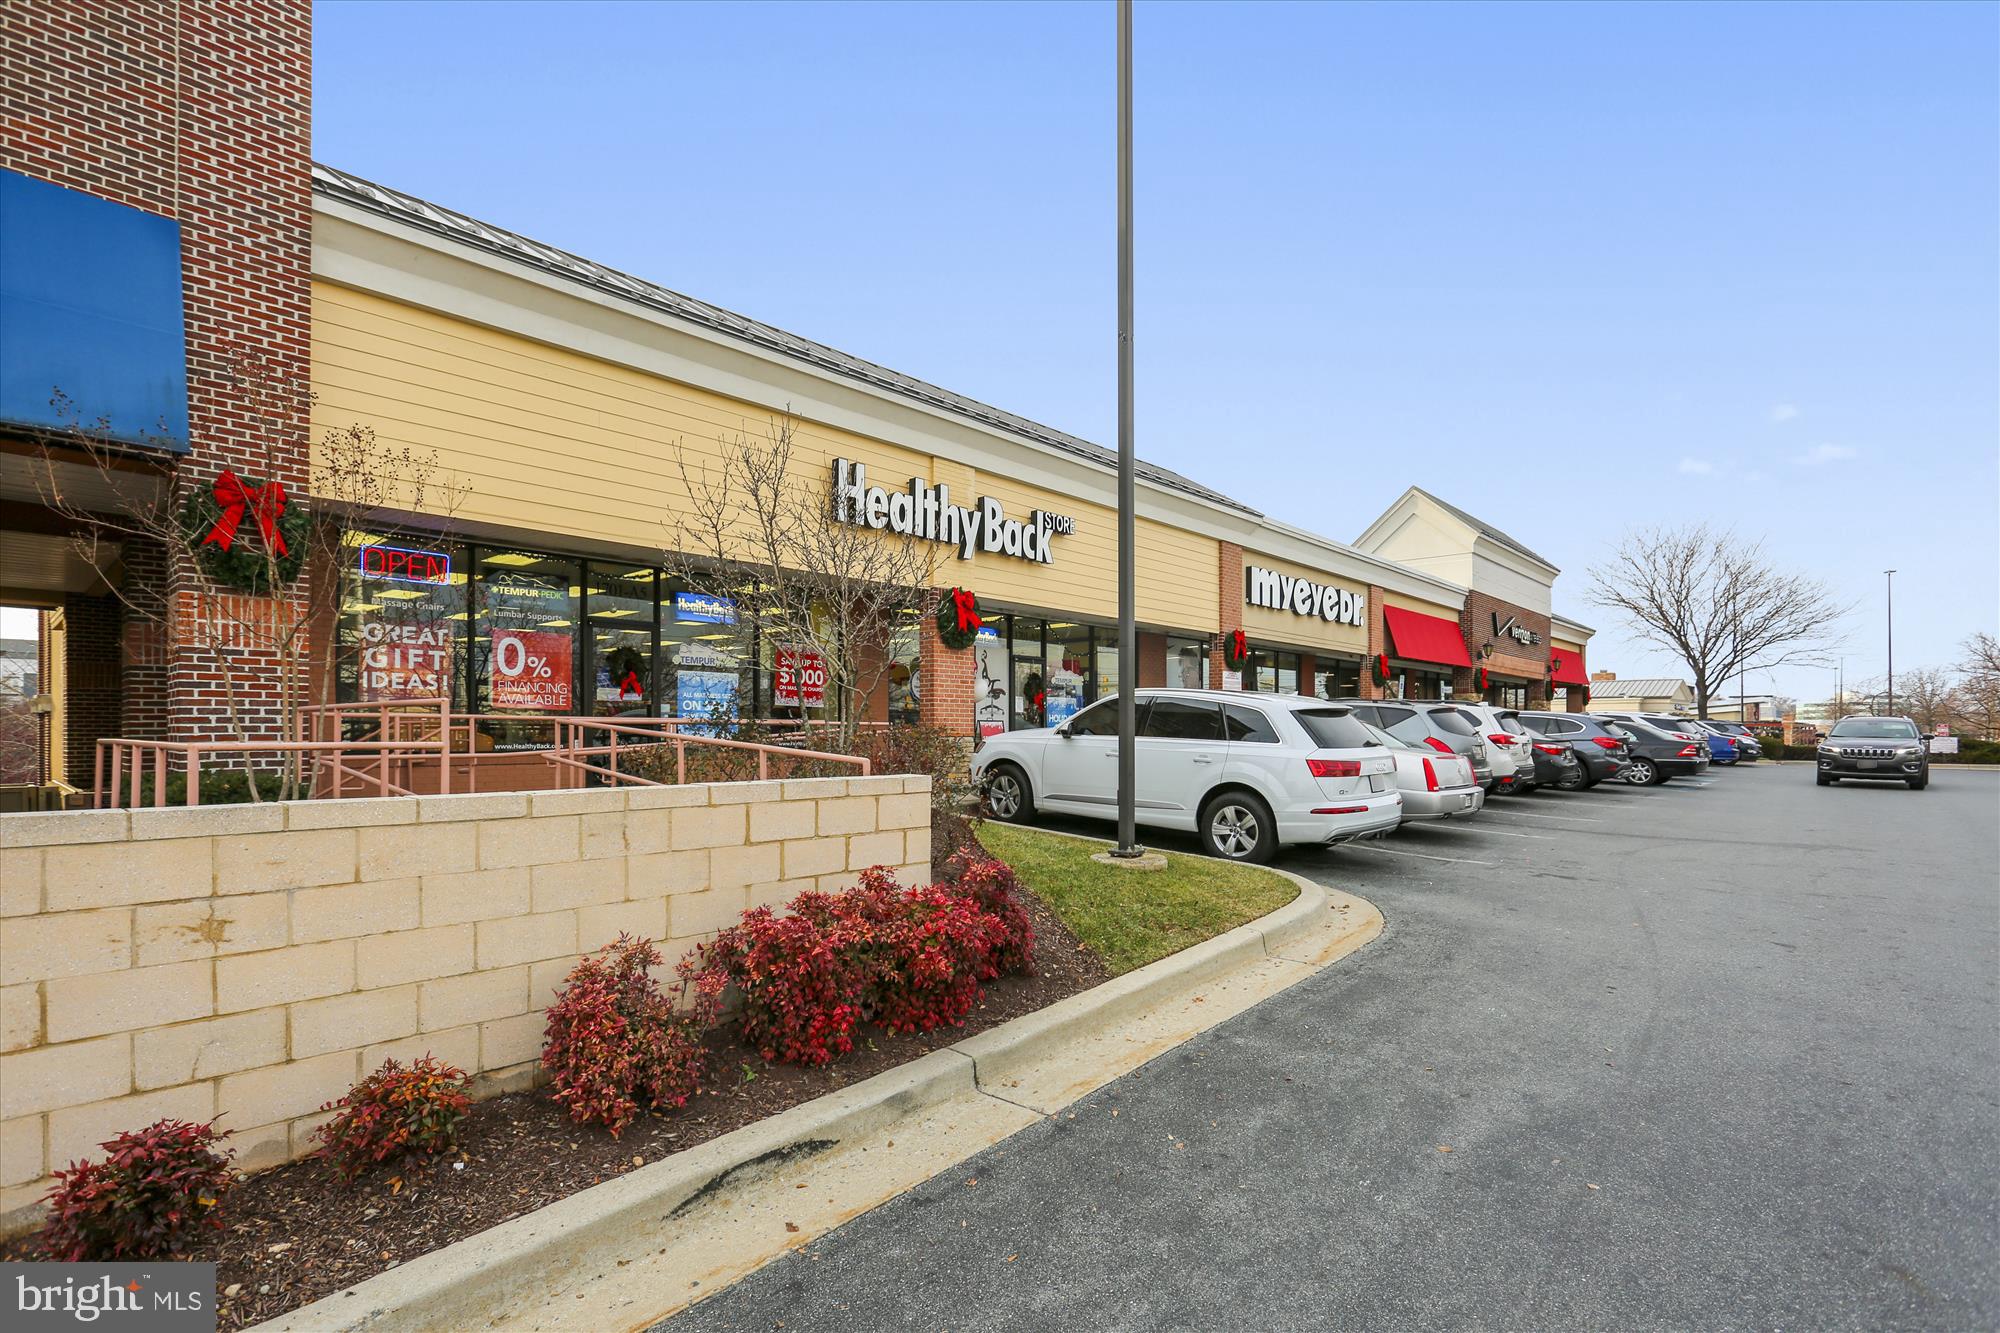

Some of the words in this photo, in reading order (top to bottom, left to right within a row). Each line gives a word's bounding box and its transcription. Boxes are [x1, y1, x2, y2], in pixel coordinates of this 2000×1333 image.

[1044, 511, 1076, 535] STORE
[363, 547, 447, 583] OPEN
[416, 601, 445, 611] Chairs
[493, 609, 525, 619] Lumbar
[527, 611, 563, 621] Supports
[363, 622, 449, 647] GREAT
[364, 647, 446, 671] GIFT
[496, 637, 552, 678] 0%
[362, 671, 449, 691] IDEAS!
[497, 680, 568, 695] FINANCING
[497, 693, 567, 706] AVAILABLE
[682, 700, 701, 711] ON
[494, 743, 564, 751] www.HealthyBack.cm
